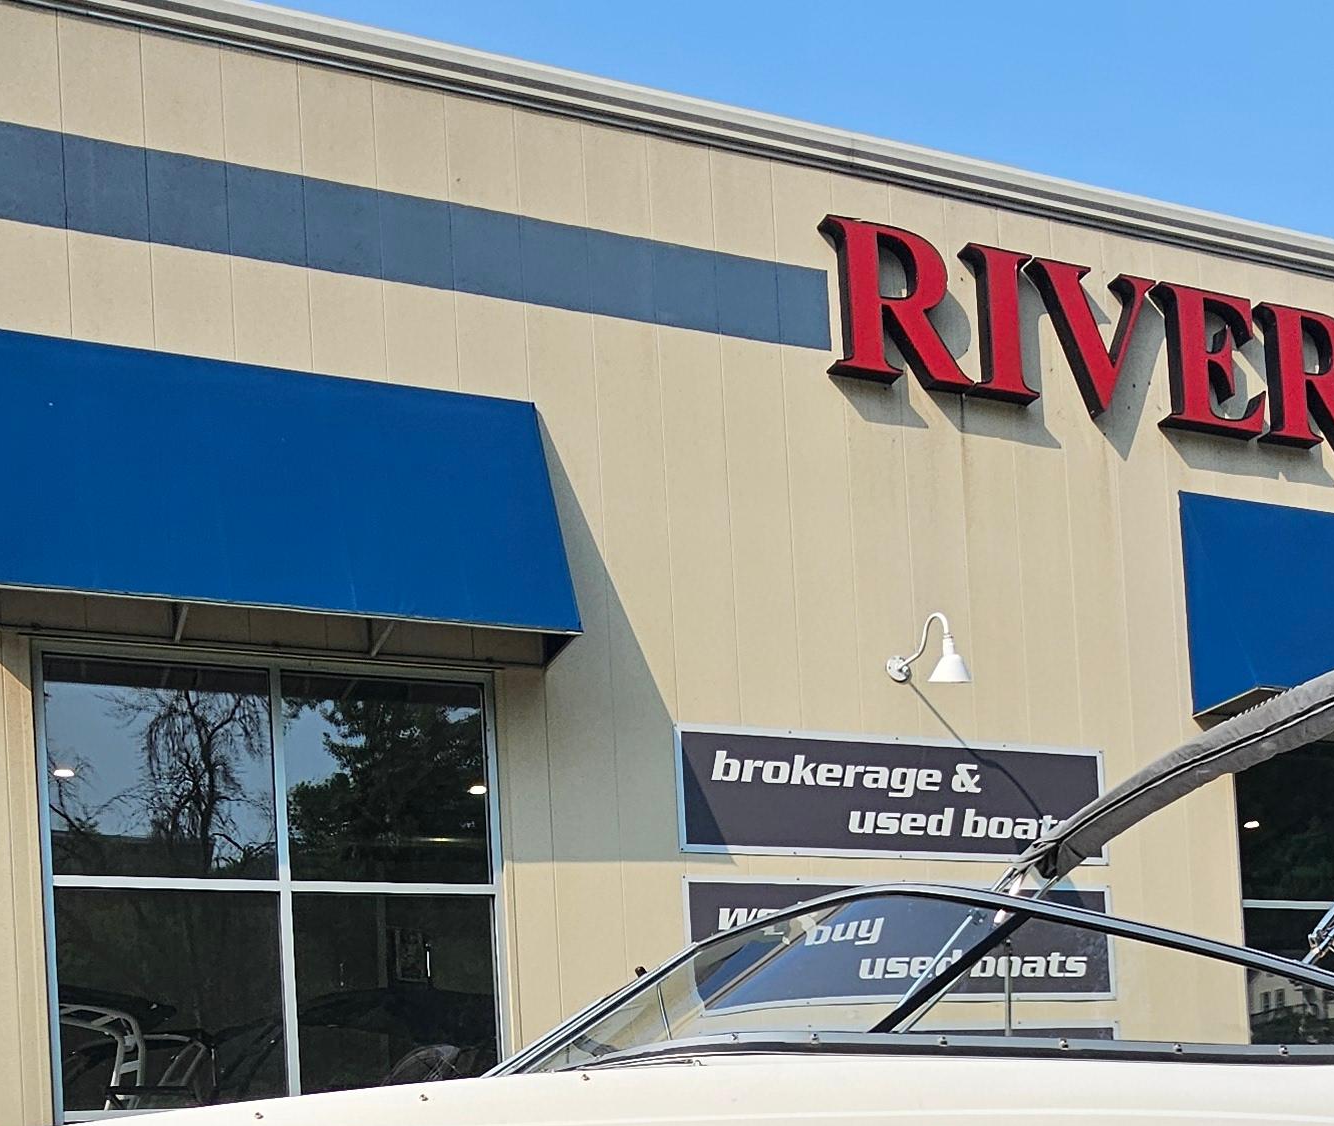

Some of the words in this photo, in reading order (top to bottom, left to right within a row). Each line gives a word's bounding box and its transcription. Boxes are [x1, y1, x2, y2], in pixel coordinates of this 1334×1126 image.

[711, 750, 942, 798] brokerage
[951, 763, 982, 794] &
[848, 806, 955, 837] used
[961, 808, 1067, 840] boat
[804, 917, 884, 946] buy
[970, 952, 1087, 978] boats
